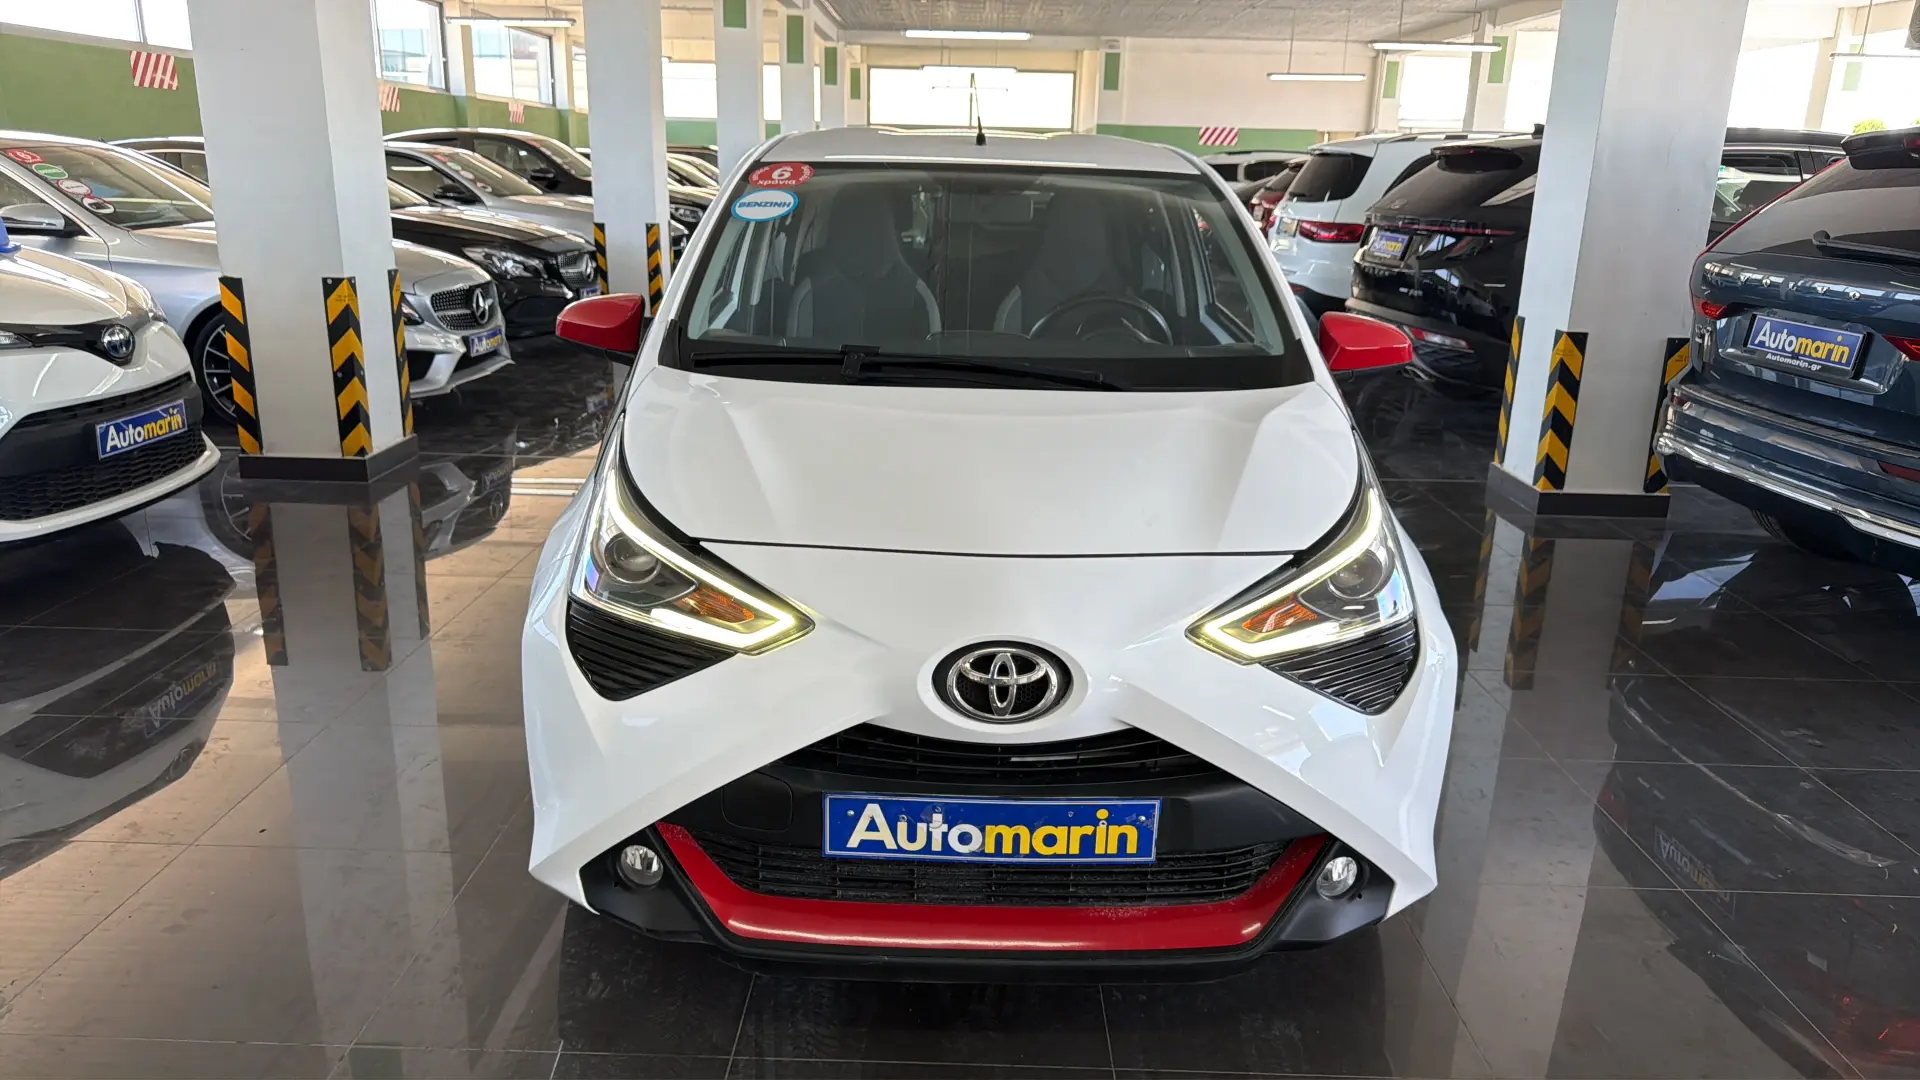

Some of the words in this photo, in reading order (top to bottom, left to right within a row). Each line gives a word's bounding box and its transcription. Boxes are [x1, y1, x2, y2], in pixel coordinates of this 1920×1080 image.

[771, 167, 793, 181] 6
[1754, 321, 1850, 364] Automarin
[1766, 352, 1822, 371] Automarin.gr
[105, 407, 183, 453] Automarin
[846, 803, 1138, 855] Automarin
